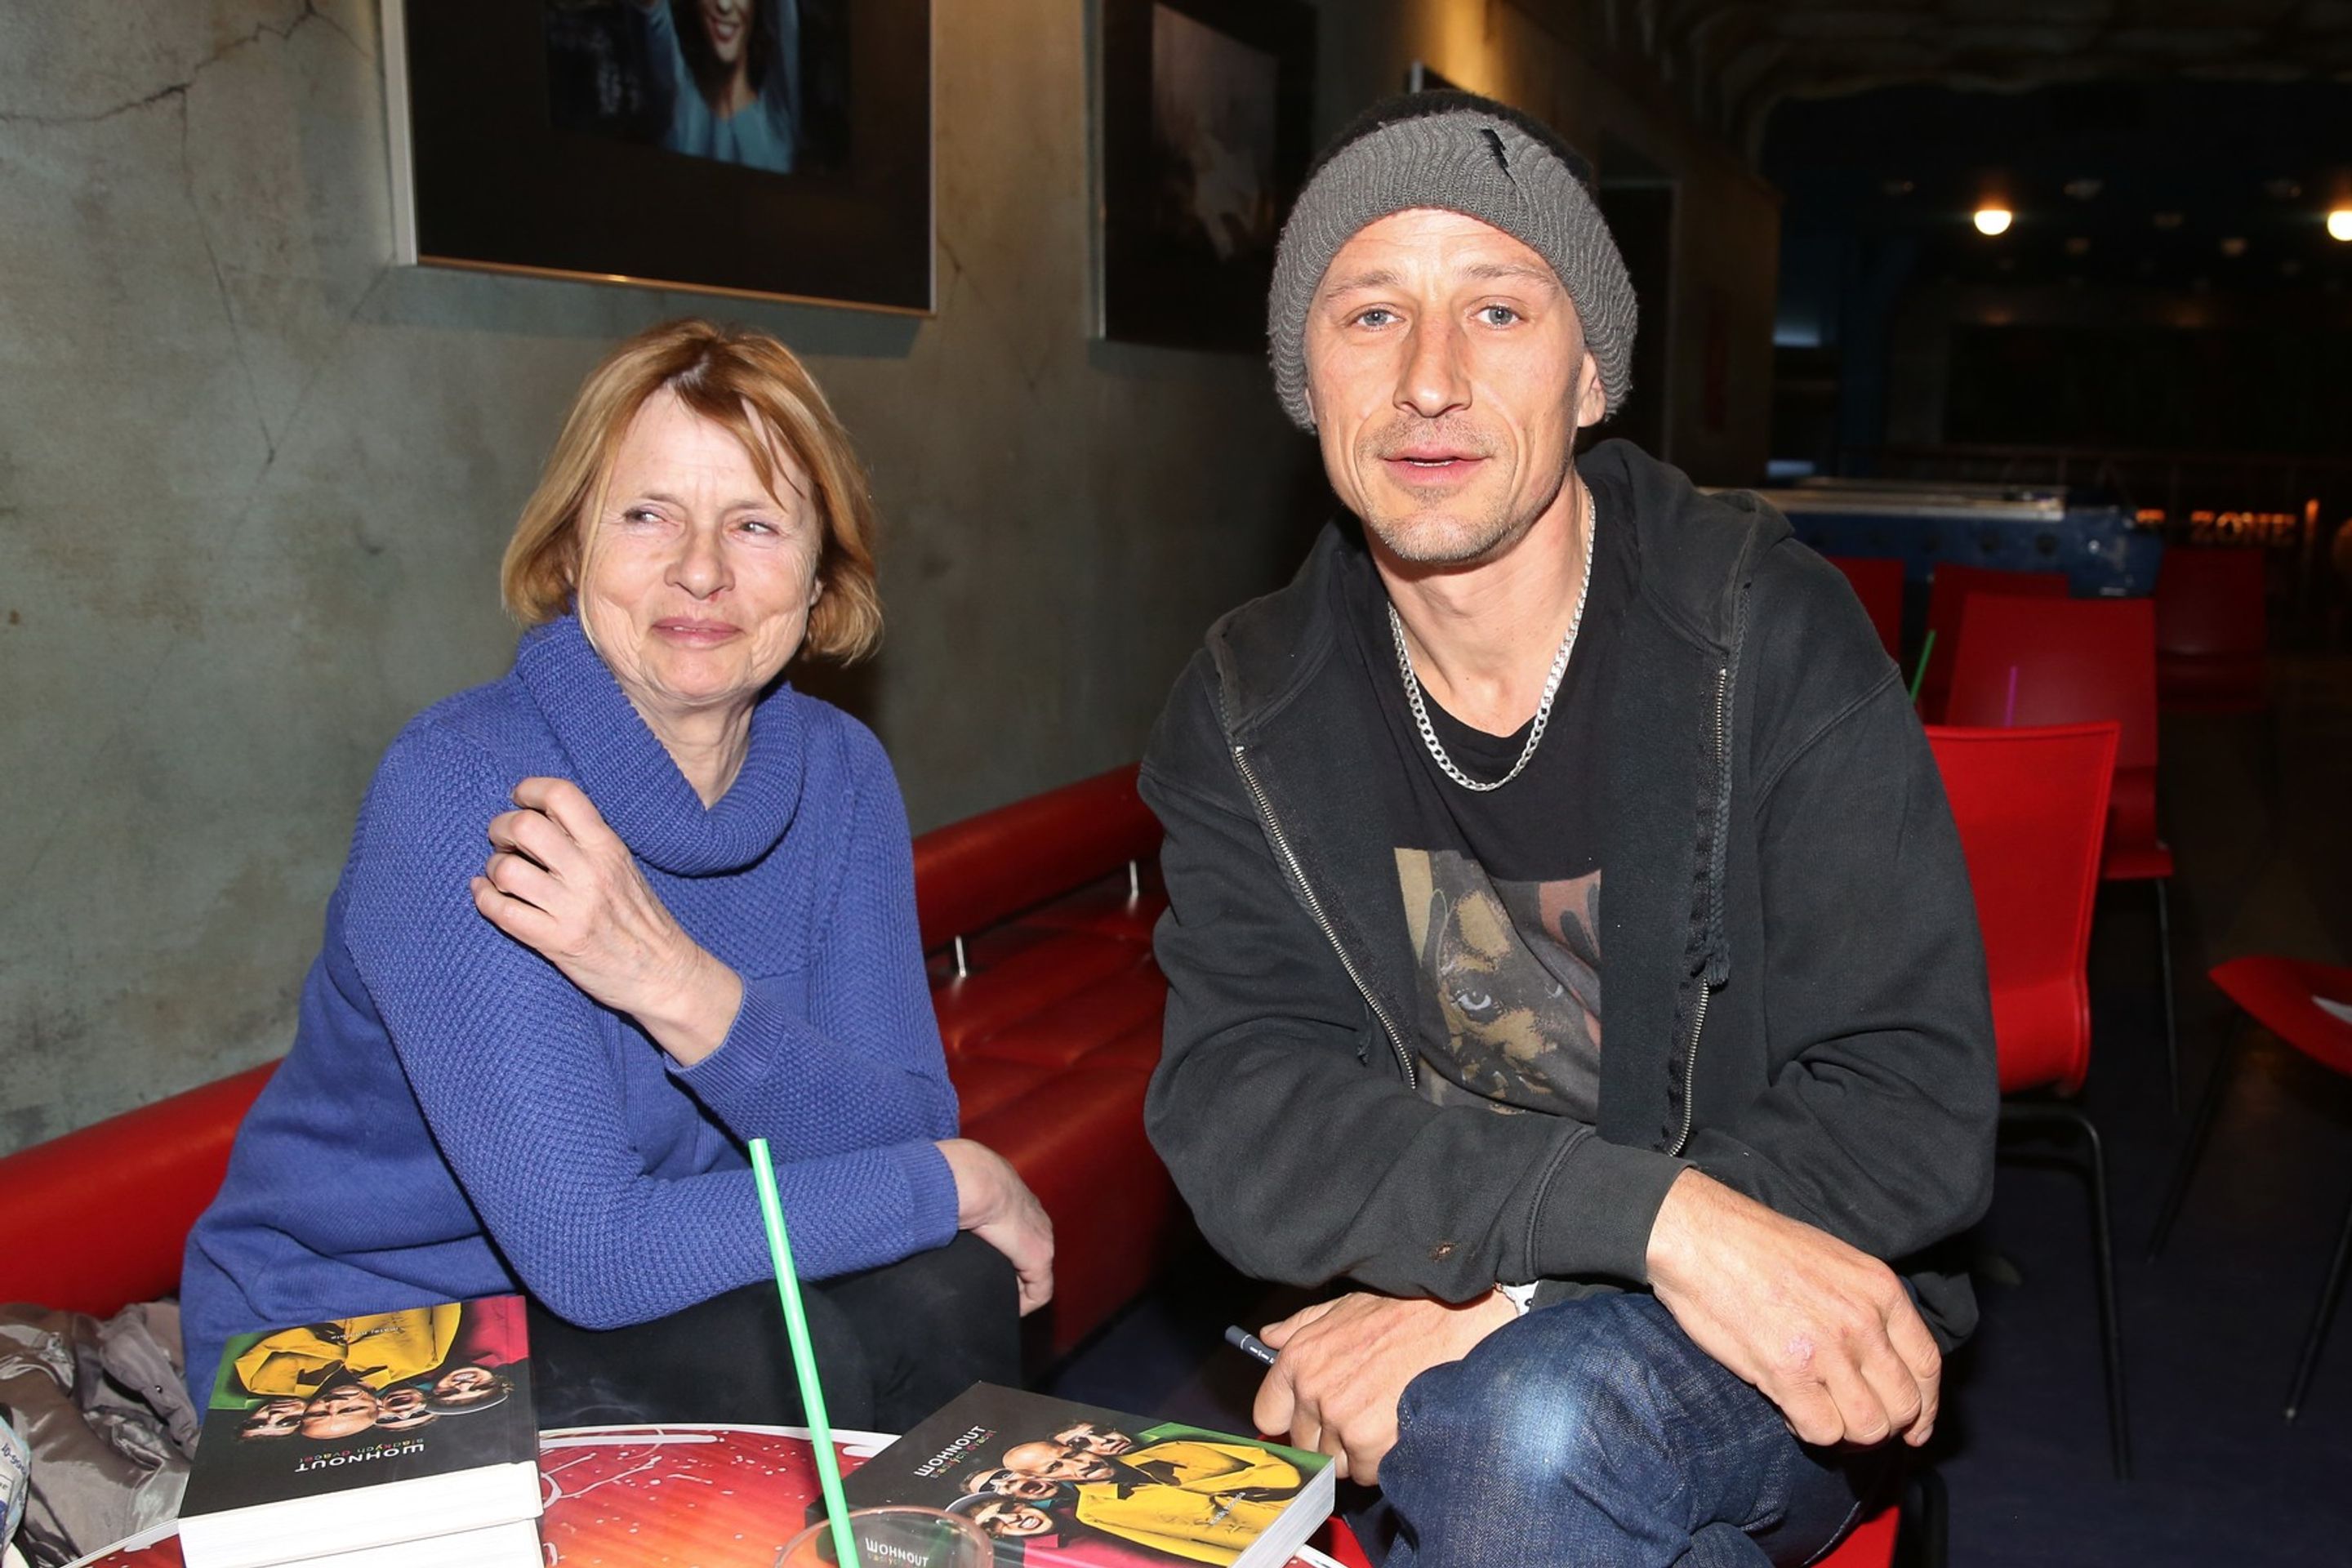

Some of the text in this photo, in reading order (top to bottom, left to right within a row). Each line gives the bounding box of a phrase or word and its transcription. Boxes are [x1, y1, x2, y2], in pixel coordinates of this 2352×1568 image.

[295, 1443, 425, 1472] WOHNOUT
[913, 1425, 986, 1477] WOHNOUT
[865, 1537, 929, 1567] WOHNOUT
